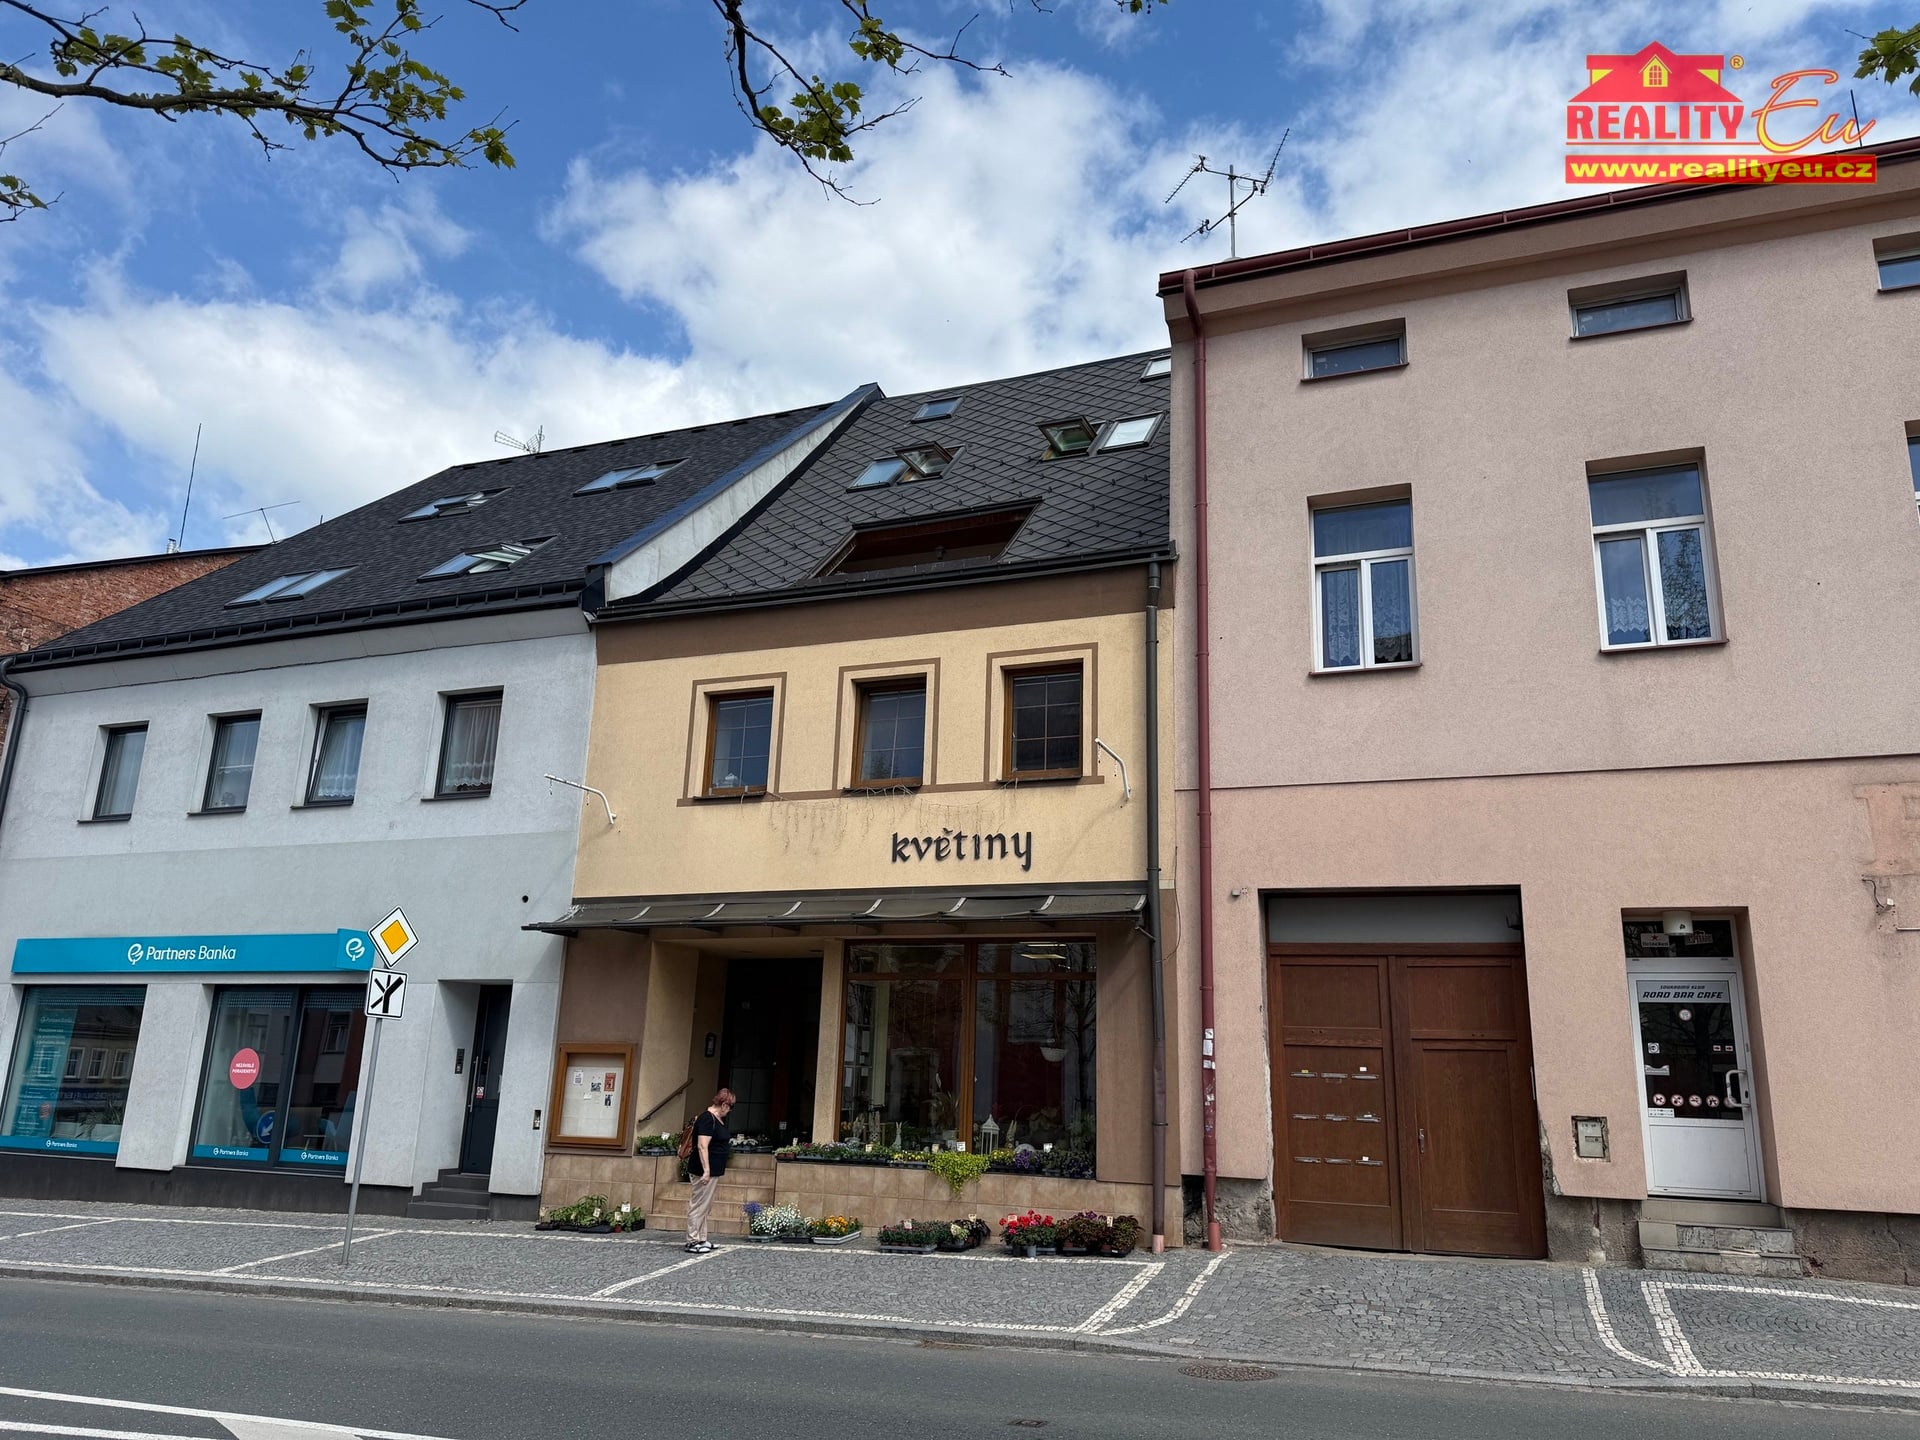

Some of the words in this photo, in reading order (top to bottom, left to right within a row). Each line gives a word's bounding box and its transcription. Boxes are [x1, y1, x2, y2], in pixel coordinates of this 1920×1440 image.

[891, 827, 1032, 872] květiny
[146, 946, 196, 961] Partners
[198, 945, 237, 960] Banka
[1642, 991, 1671, 999] ROAD
[1673, 991, 1695, 999] BAR
[1697, 991, 1724, 999] CAFE
